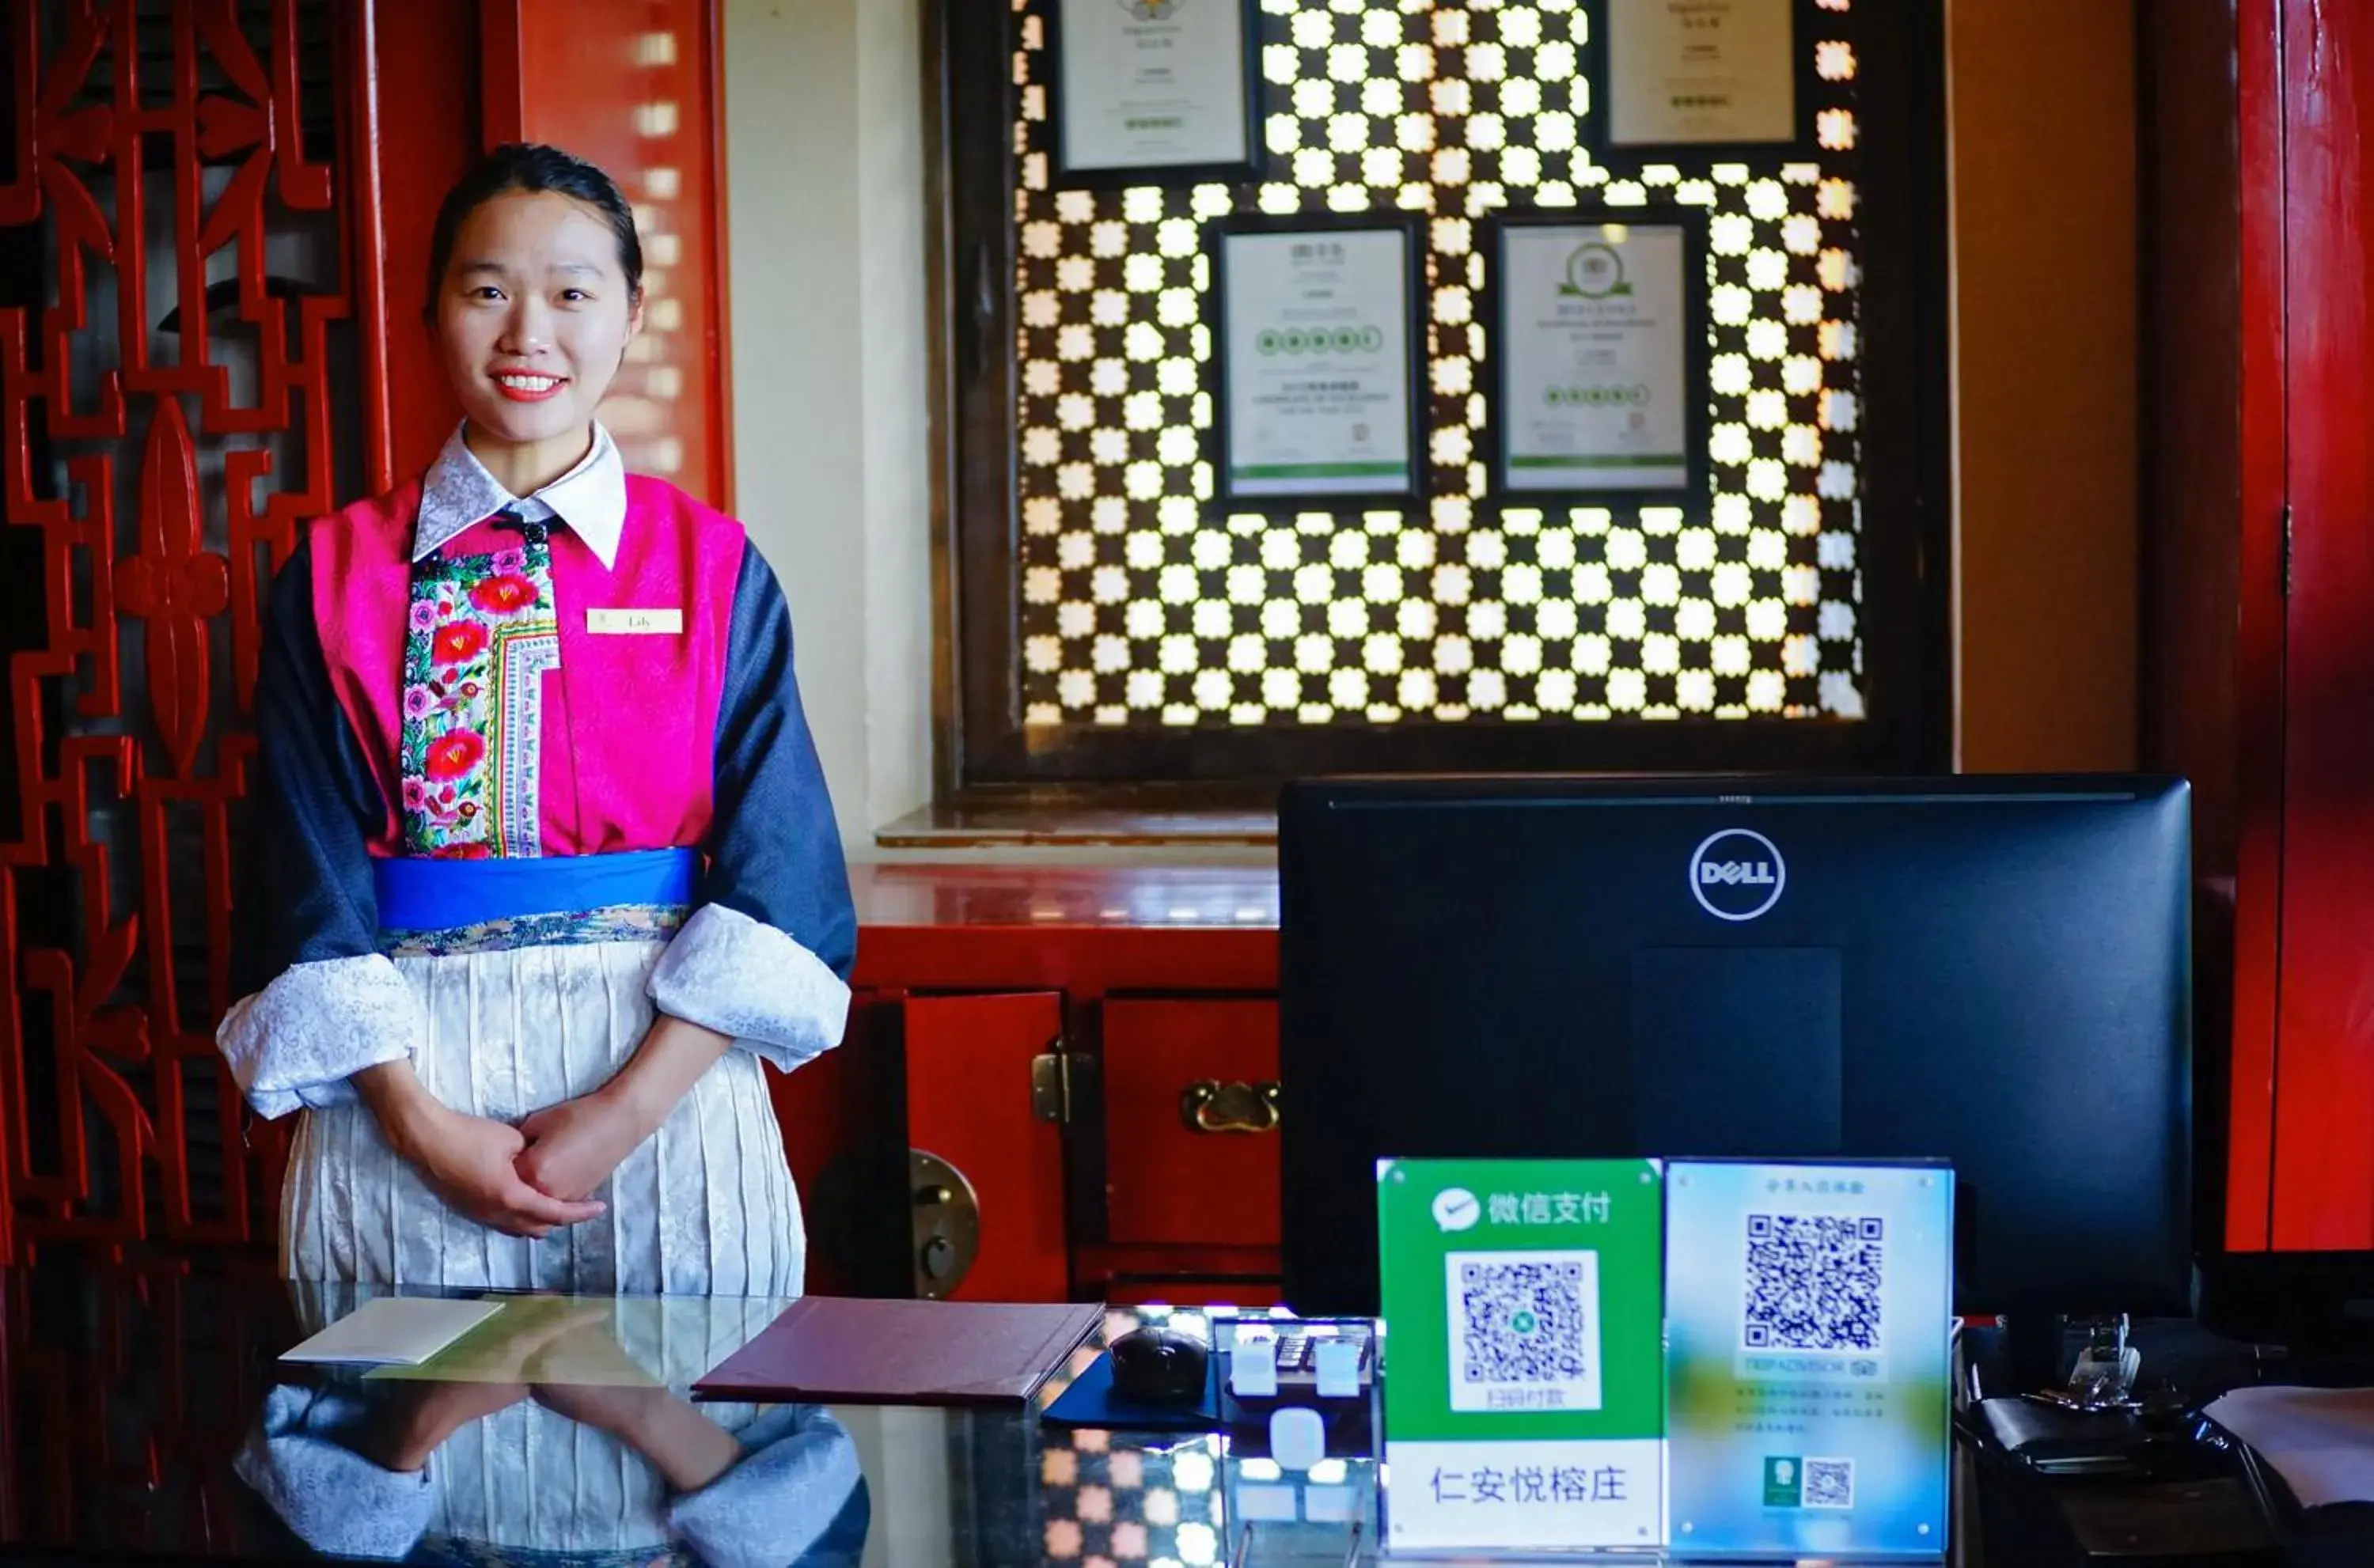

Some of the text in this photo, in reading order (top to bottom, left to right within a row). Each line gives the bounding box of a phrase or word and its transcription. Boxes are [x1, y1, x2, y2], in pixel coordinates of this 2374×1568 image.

[628, 616, 650, 631] Lily
[1701, 861, 1775, 885] DELL
[1488, 1191, 1611, 1224] 微信支付
[1430, 1466, 1628, 1504] 仁安悦榕庄
